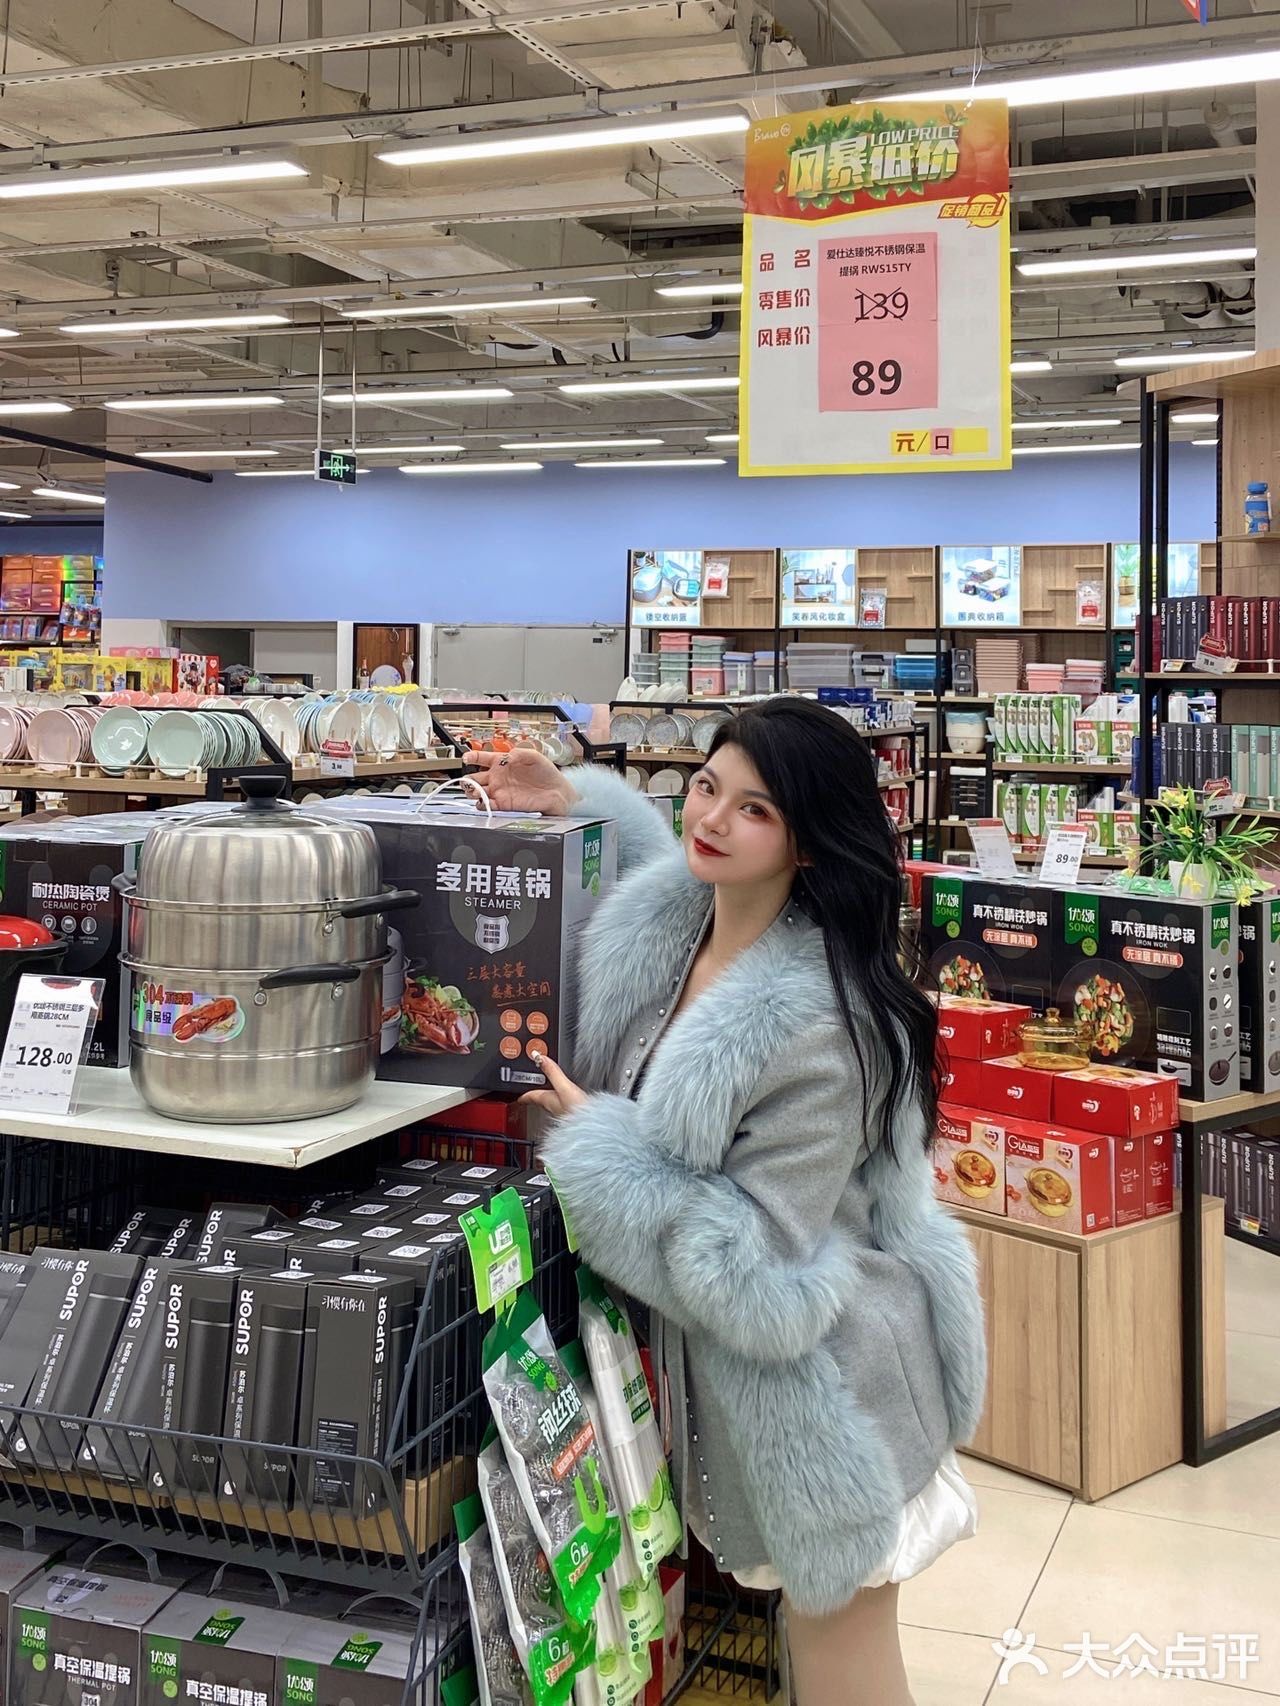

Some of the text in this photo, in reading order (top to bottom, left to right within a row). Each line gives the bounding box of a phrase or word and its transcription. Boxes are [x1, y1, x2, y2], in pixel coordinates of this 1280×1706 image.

[870, 125, 960, 147] LOW PRICE
[787, 135, 960, 198] 风暴低价
[760, 250, 811, 272] 品 名
[826, 242, 926, 260] 爱仕达臻悦不锈钢保温
[839, 262, 912, 277] 提锅 RWS15TY
[758, 288, 811, 311] 零售价
[757, 326, 811, 348] 风暴价
[851, 359, 902, 397] 89
[436, 861, 551, 899] 多用蒸锅
[32, 882, 111, 902] 耐热陶瓷煲
[935, 892, 960, 908] 优颂
[42, 900, 97, 911] CERAMIC POT
[464, 896, 522, 911] STEAMER
[935, 907, 959, 918] SONG
[1068, 907, 1096, 924] 优颂
[1068, 922, 1095, 934] SONG
[1136, 939, 1152, 947] IRON
[142, 980, 165, 1005] 304
[146, 1009, 172, 1025] 食品级
[16, 1045, 73, 1068] 128.00
[110, 1211, 147, 1254] SUPOR
[160, 1218, 193, 1259] UPOR
[196, 1209, 223, 1263] SUPOR
[59, 1259, 90, 1321] SUPOR
[127, 1267, 159, 1329] SUPOR
[321, 1294, 366, 1313] 习惯有你在
[164, 1283, 183, 1350] SUPOR
[235, 1288, 255, 1356] SUPOR
[374, 1295, 388, 1365] SUPOR
[528, 1361, 546, 1380] SONG
[537, 1382, 582, 1445] 钢丝球
[21, 1637, 46, 1651] SONG
[346, 1643, 375, 1655] SONG
[54, 1653, 131, 1685] 真空保温提锅
[150, 1664, 177, 1677] SONG
[67, 1675, 116, 1692] THERMAL POT
[186, 1679, 268, 1706] 真空保温提锅
[286, 1688, 313, 1703] SONG
